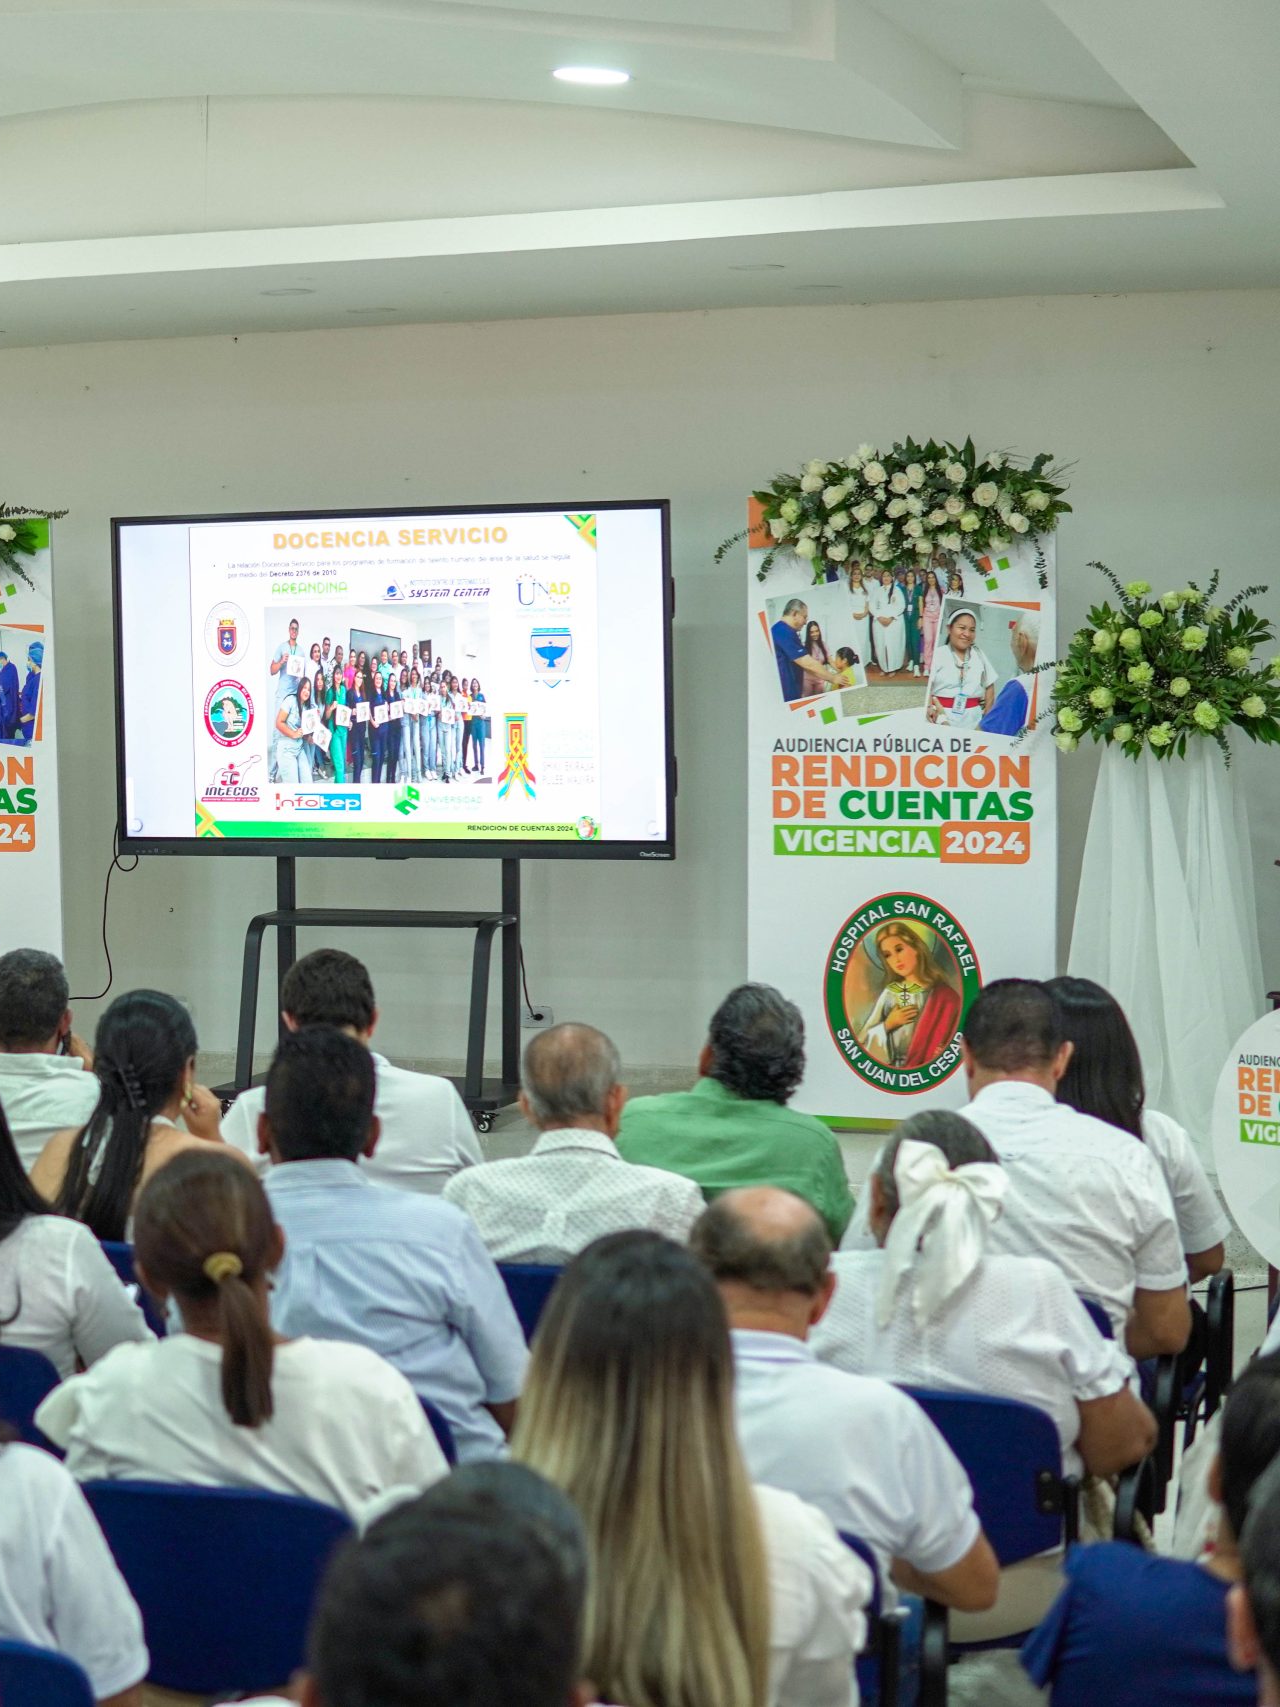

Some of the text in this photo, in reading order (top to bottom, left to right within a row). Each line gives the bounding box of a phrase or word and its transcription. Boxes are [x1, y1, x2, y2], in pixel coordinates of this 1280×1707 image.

[273, 526, 508, 549] DOCENCIA SERVICIO
[271, 581, 348, 595] AREANDINA
[773, 734, 971, 753] AUDIENCIA PÚBLICA DE
[772, 746, 1030, 788] RENDICIÓN
[773, 790, 1034, 821] DE CUENTAS
[779, 829, 1025, 855] VIGENCIA 2024
[832, 901, 976, 976] HOSPITAL SAN RAFAEL
[837, 1027, 859, 1060] SAN
[857, 1059, 896, 1086] JUAN
[899, 1071, 930, 1087] DEL
[1239, 1092, 1272, 1117] DE
[1244, 1121, 1280, 1143] VIG
